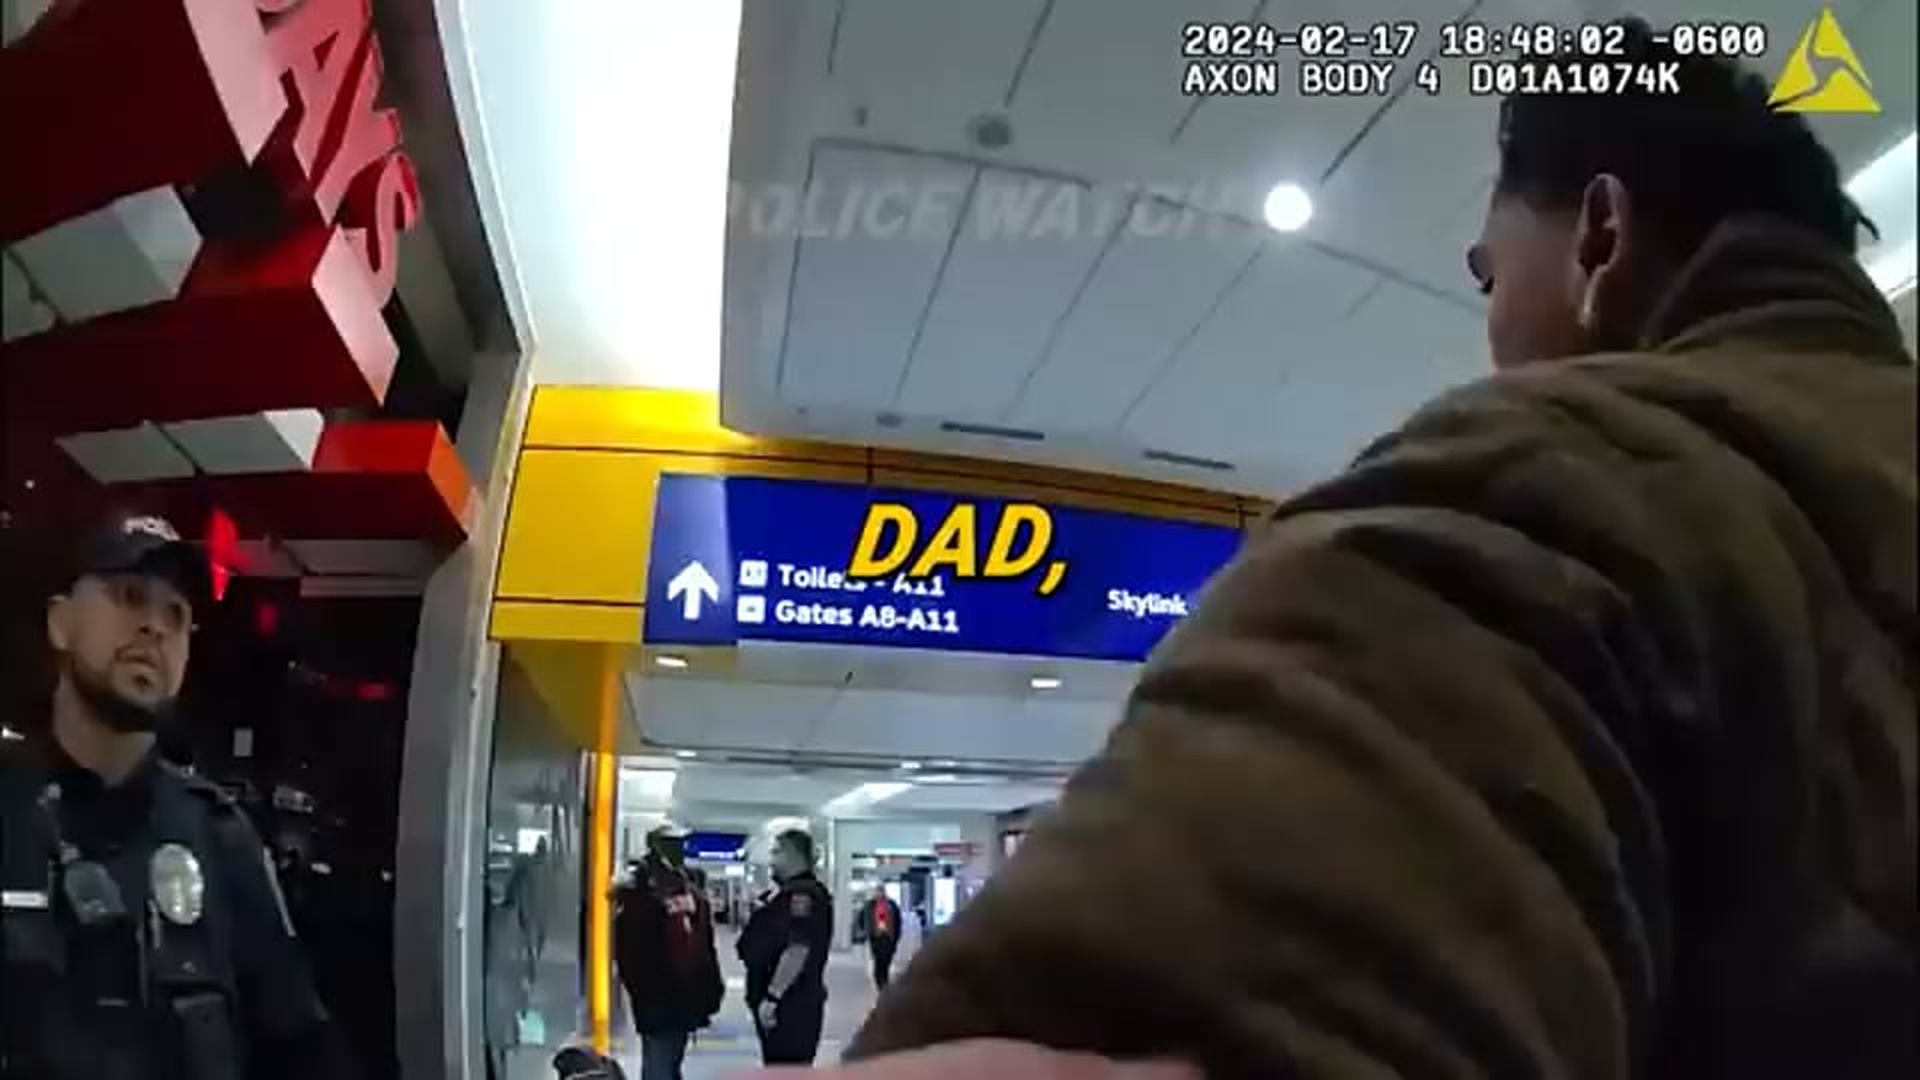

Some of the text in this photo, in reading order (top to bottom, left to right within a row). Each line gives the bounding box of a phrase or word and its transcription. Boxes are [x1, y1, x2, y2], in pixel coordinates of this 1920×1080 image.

[256, 0, 420, 312] AYS
[776, 562, 868, 592] Toile
[775, 599, 960, 633] Gates A8-A11
[1107, 588, 1190, 619] Skylink
